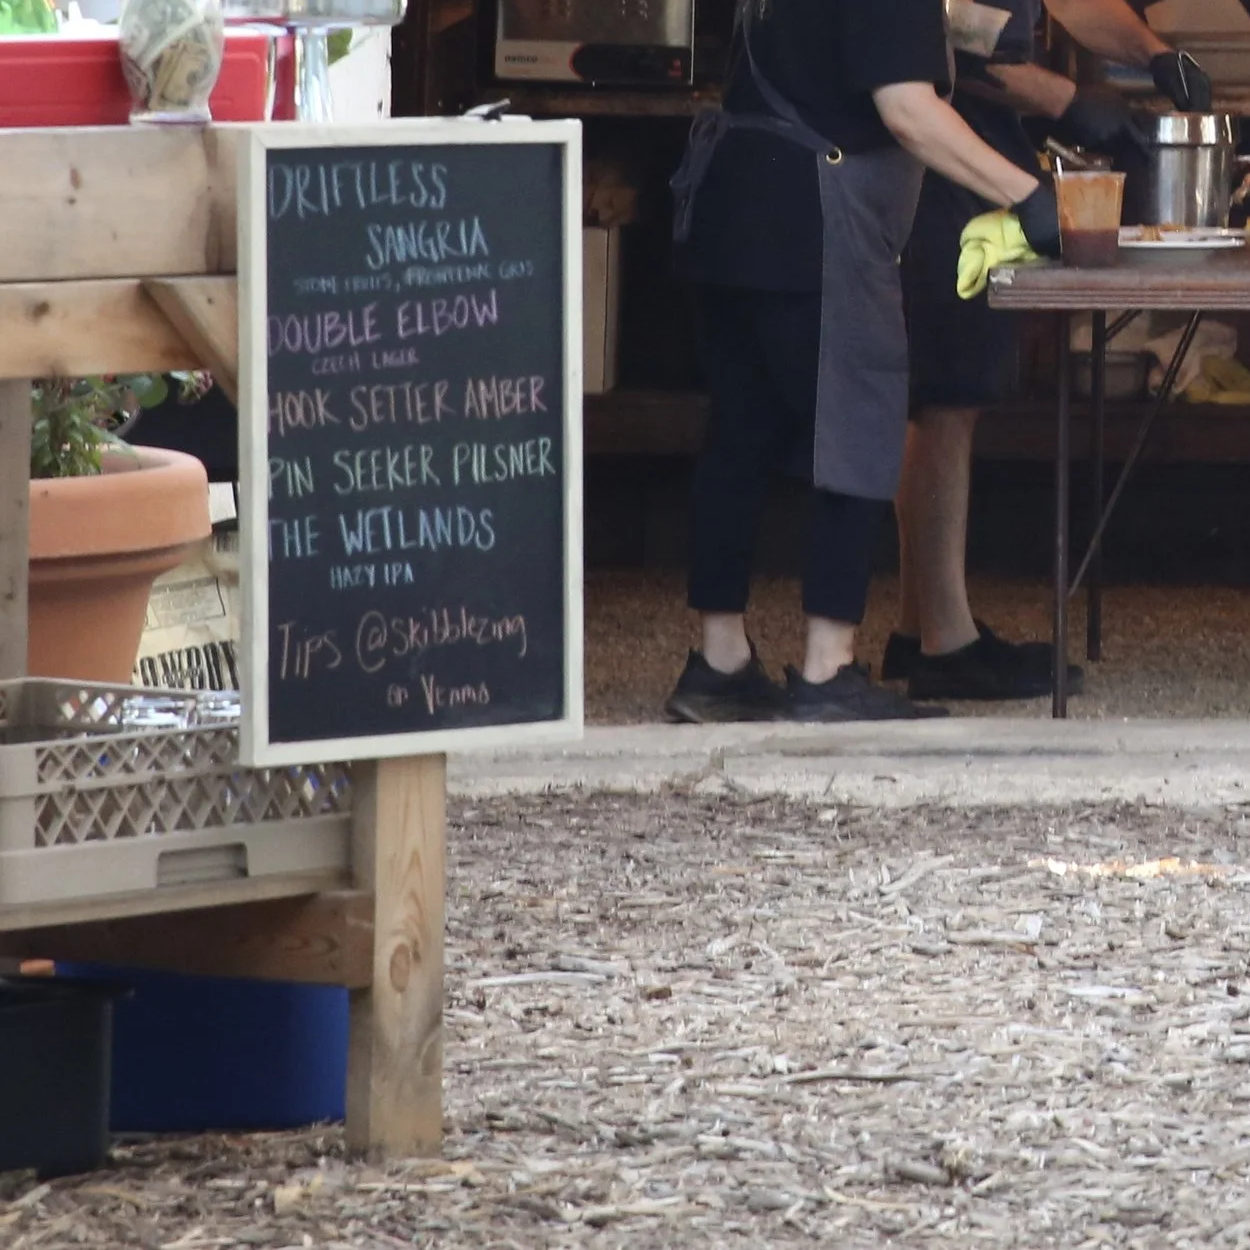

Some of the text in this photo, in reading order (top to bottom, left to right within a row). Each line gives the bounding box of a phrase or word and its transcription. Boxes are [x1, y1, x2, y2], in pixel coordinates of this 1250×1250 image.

[267, 161, 448, 219] DRIFTLESS
[367, 216, 489, 270] SANGRIA
[267, 287, 499, 356] DOUBLE ELBOW
[266, 373, 547, 437] HOOK SETTER AMBER
[266, 436, 557, 499] PIN SEEKER PILSNER
[267, 505, 496, 561] THE WETLANDS
[330, 562, 415, 590] HAZY IPA
